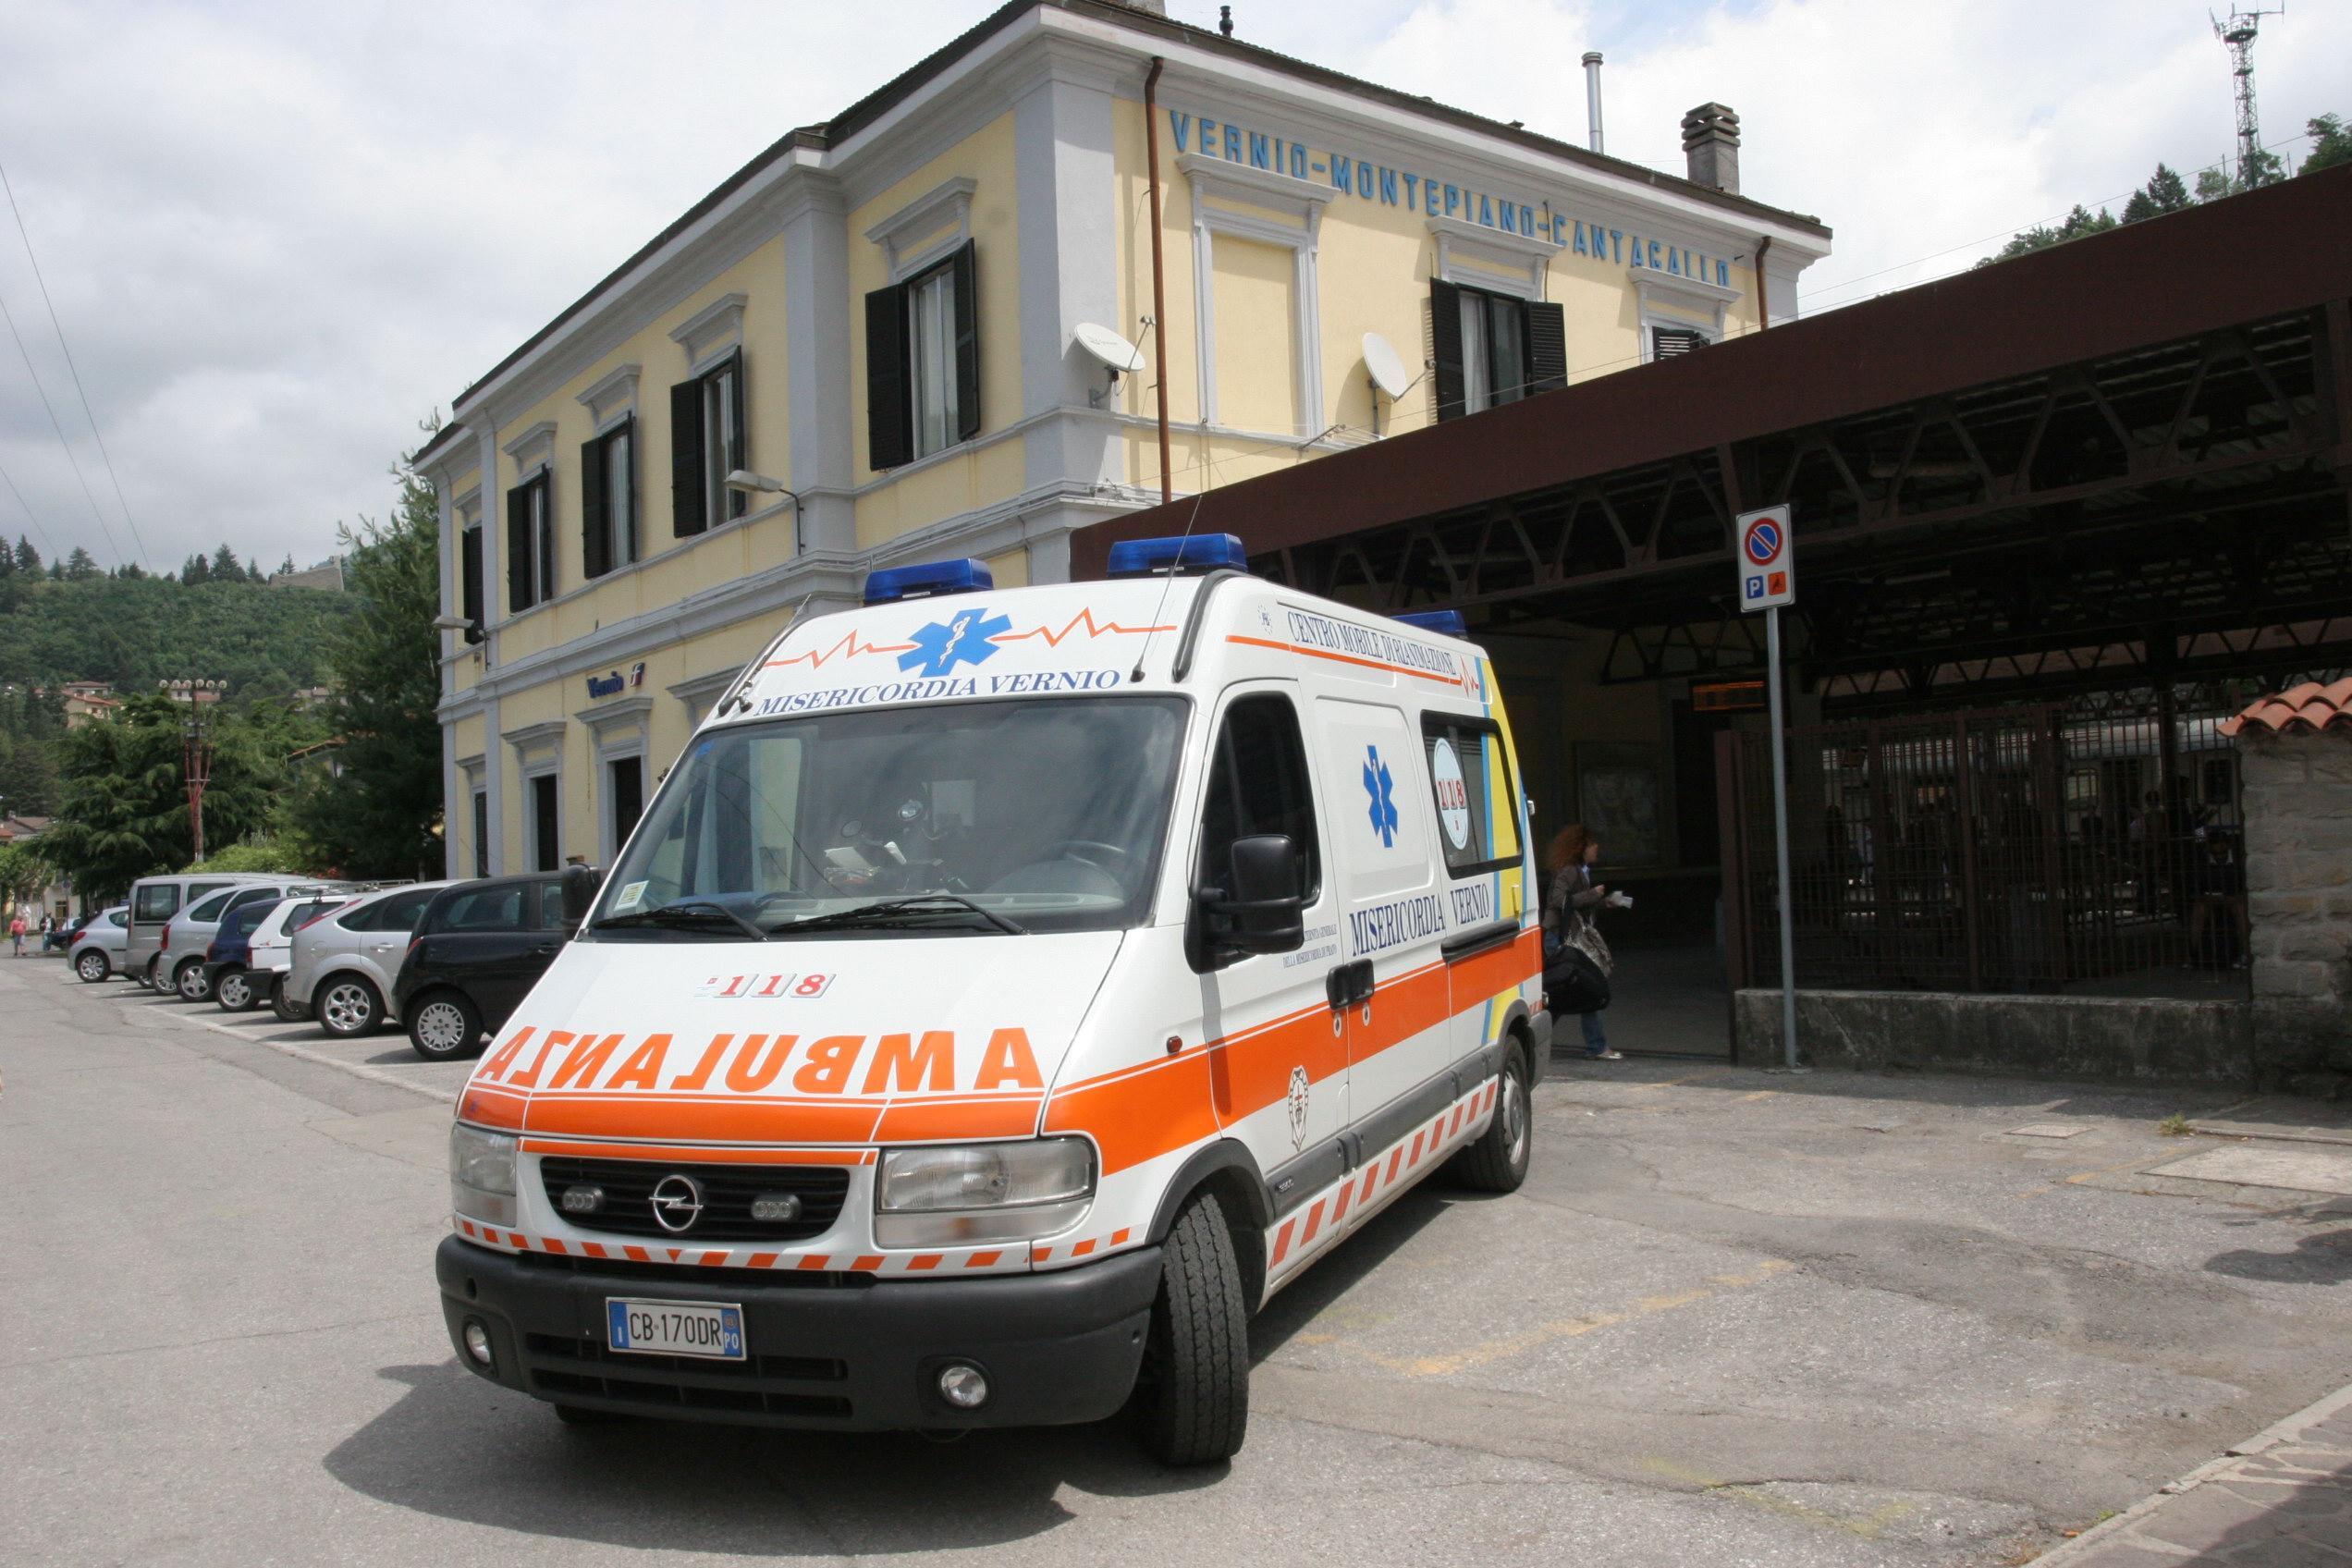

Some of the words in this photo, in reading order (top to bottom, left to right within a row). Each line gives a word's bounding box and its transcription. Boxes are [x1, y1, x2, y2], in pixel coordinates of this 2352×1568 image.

[1288, 611, 1340, 649] CENTRO
[1337, 623, 1382, 658] MOBILE
[753, 678, 976, 717] MISERICORDIA
[988, 669, 1121, 693] VERNIO
[1438, 780, 1465, 807] 118
[1349, 893, 1445, 957] MISERICORDIA
[1451, 883, 1489, 925] VERNIO
[719, 974, 826, 996] 118
